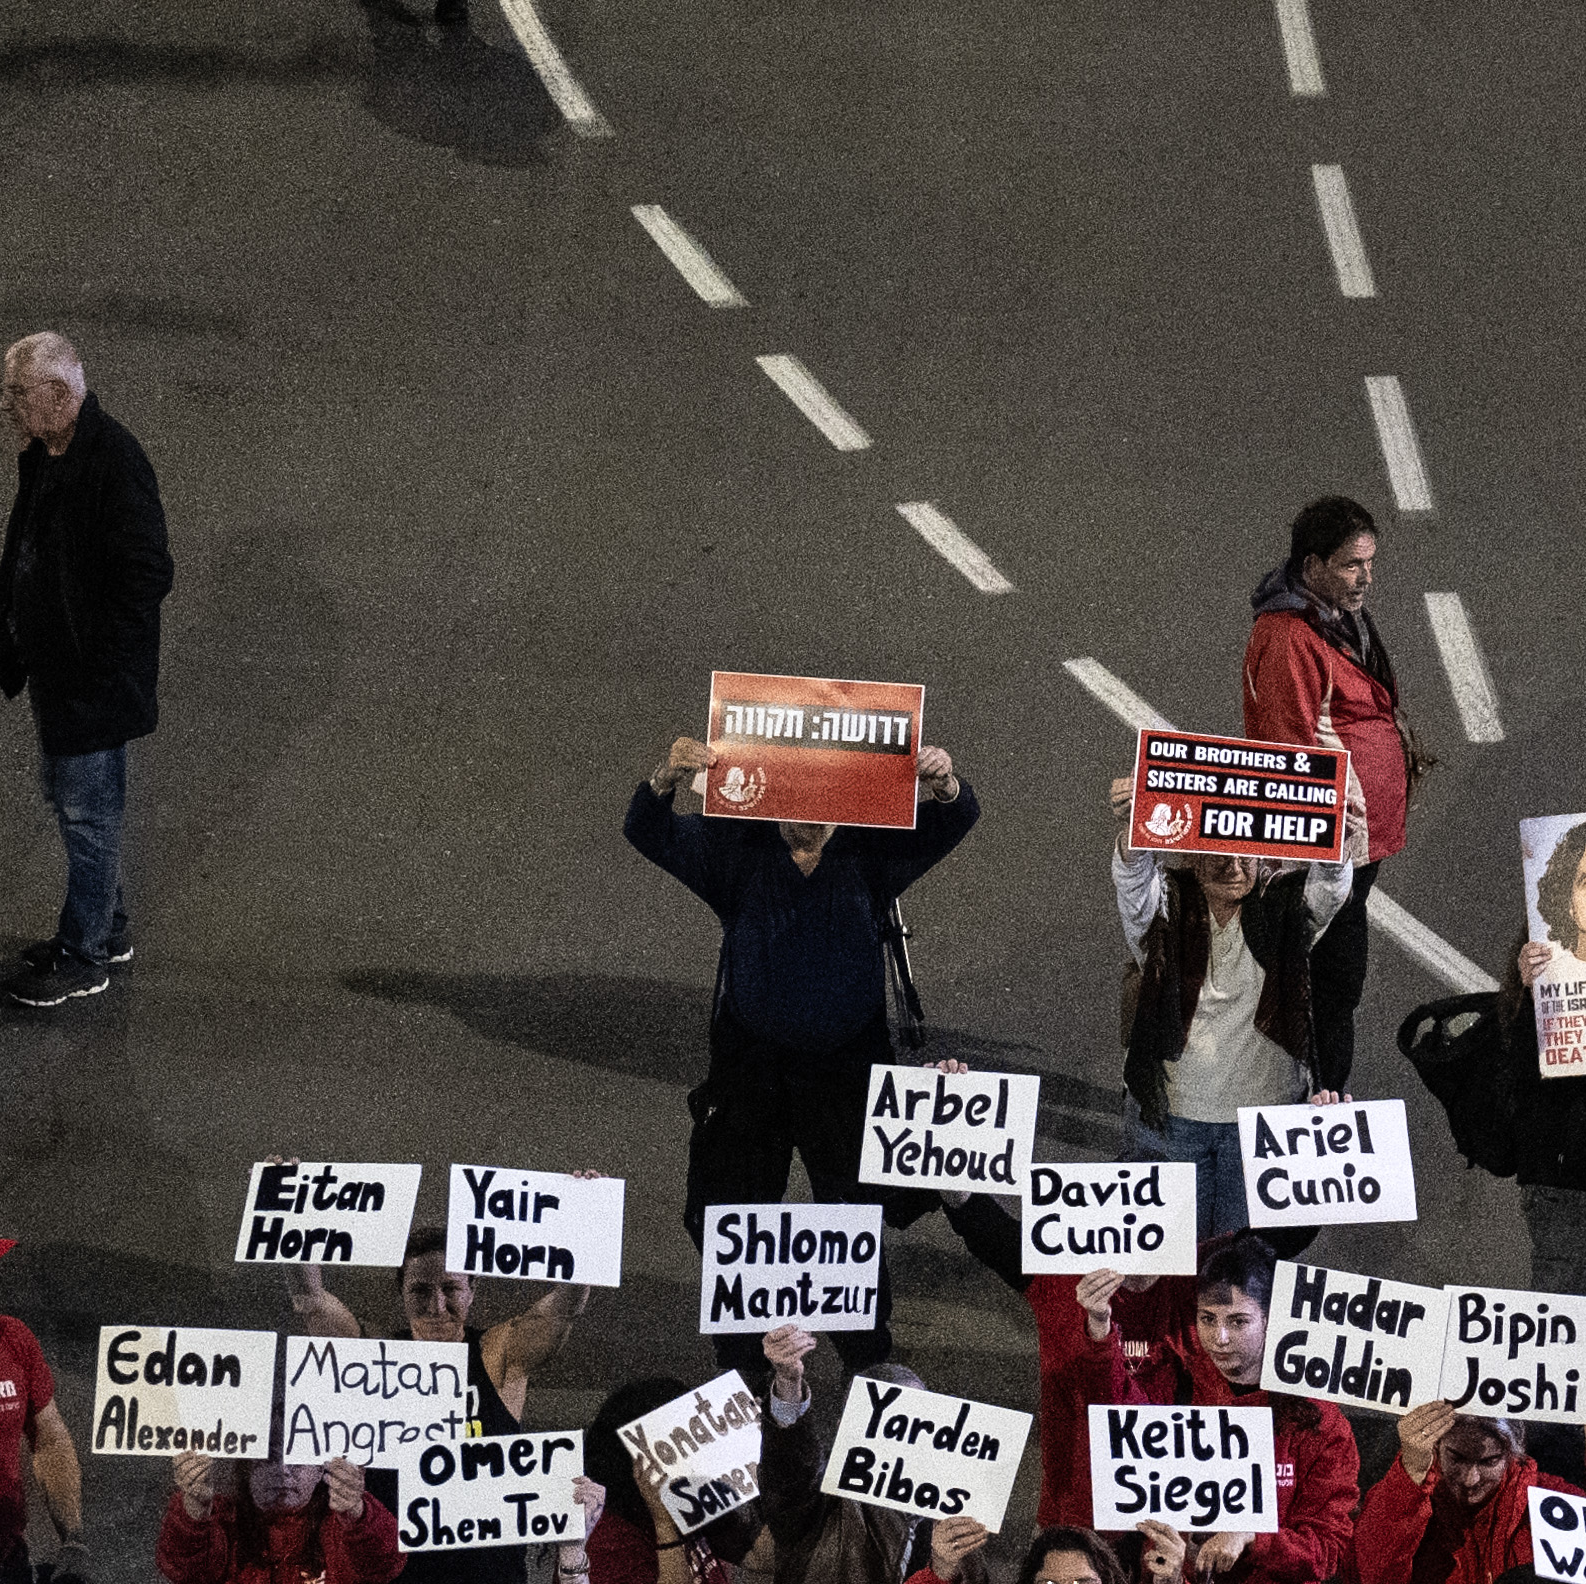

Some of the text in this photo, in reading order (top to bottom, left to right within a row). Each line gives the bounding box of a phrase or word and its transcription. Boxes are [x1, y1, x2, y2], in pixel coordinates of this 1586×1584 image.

[725, 705, 909, 746] דרושה: תקווה
[1150, 741, 1311, 773] OUR BROTHERS &
[1147, 770, 1337, 805] SISTERS ARE CALLING
[1204, 809, 1253, 837] FOR
[1264, 814, 1328, 843] HELP
[1540, 984, 1561, 998] MY
[1544, 1030, 1586, 1047] THEY
[871, 1071, 1009, 1129] Arbel
[873, 1126, 1017, 1186] Yehoud
[1254, 1110, 1375, 1159] Ariel
[254, 1165, 385, 1213] Eitan
[465, 1169, 561, 1224] Yair
[1030, 1165, 1167, 1208] David
[1257, 1163, 1381, 1210] Cunio
[246, 1216, 353, 1262] Horn
[465, 1225, 575, 1280] Horn
[715, 1212, 876, 1265] Shlomo
[1031, 1213, 1165, 1256] Cunio
[710, 1272, 878, 1323] Mantzur
[1290, 1264, 1426, 1339] Hadar
[1458, 1292, 1576, 1360] Bipin
[105, 1331, 242, 1387] Edan
[290, 1341, 463, 1399] Matan
[1273, 1330, 1413, 1409] Goldin
[1444, 1357, 1579, 1414] Joshi
[96, 1396, 258, 1454] Alexander
[865, 1381, 1000, 1461] Yarden
[1107, 1409, 1249, 1461] Keith
[837, 1446, 972, 1514] Bibas
[1114, 1463, 1263, 1527] Siegel
[400, 1493, 568, 1549] Shem Tov
